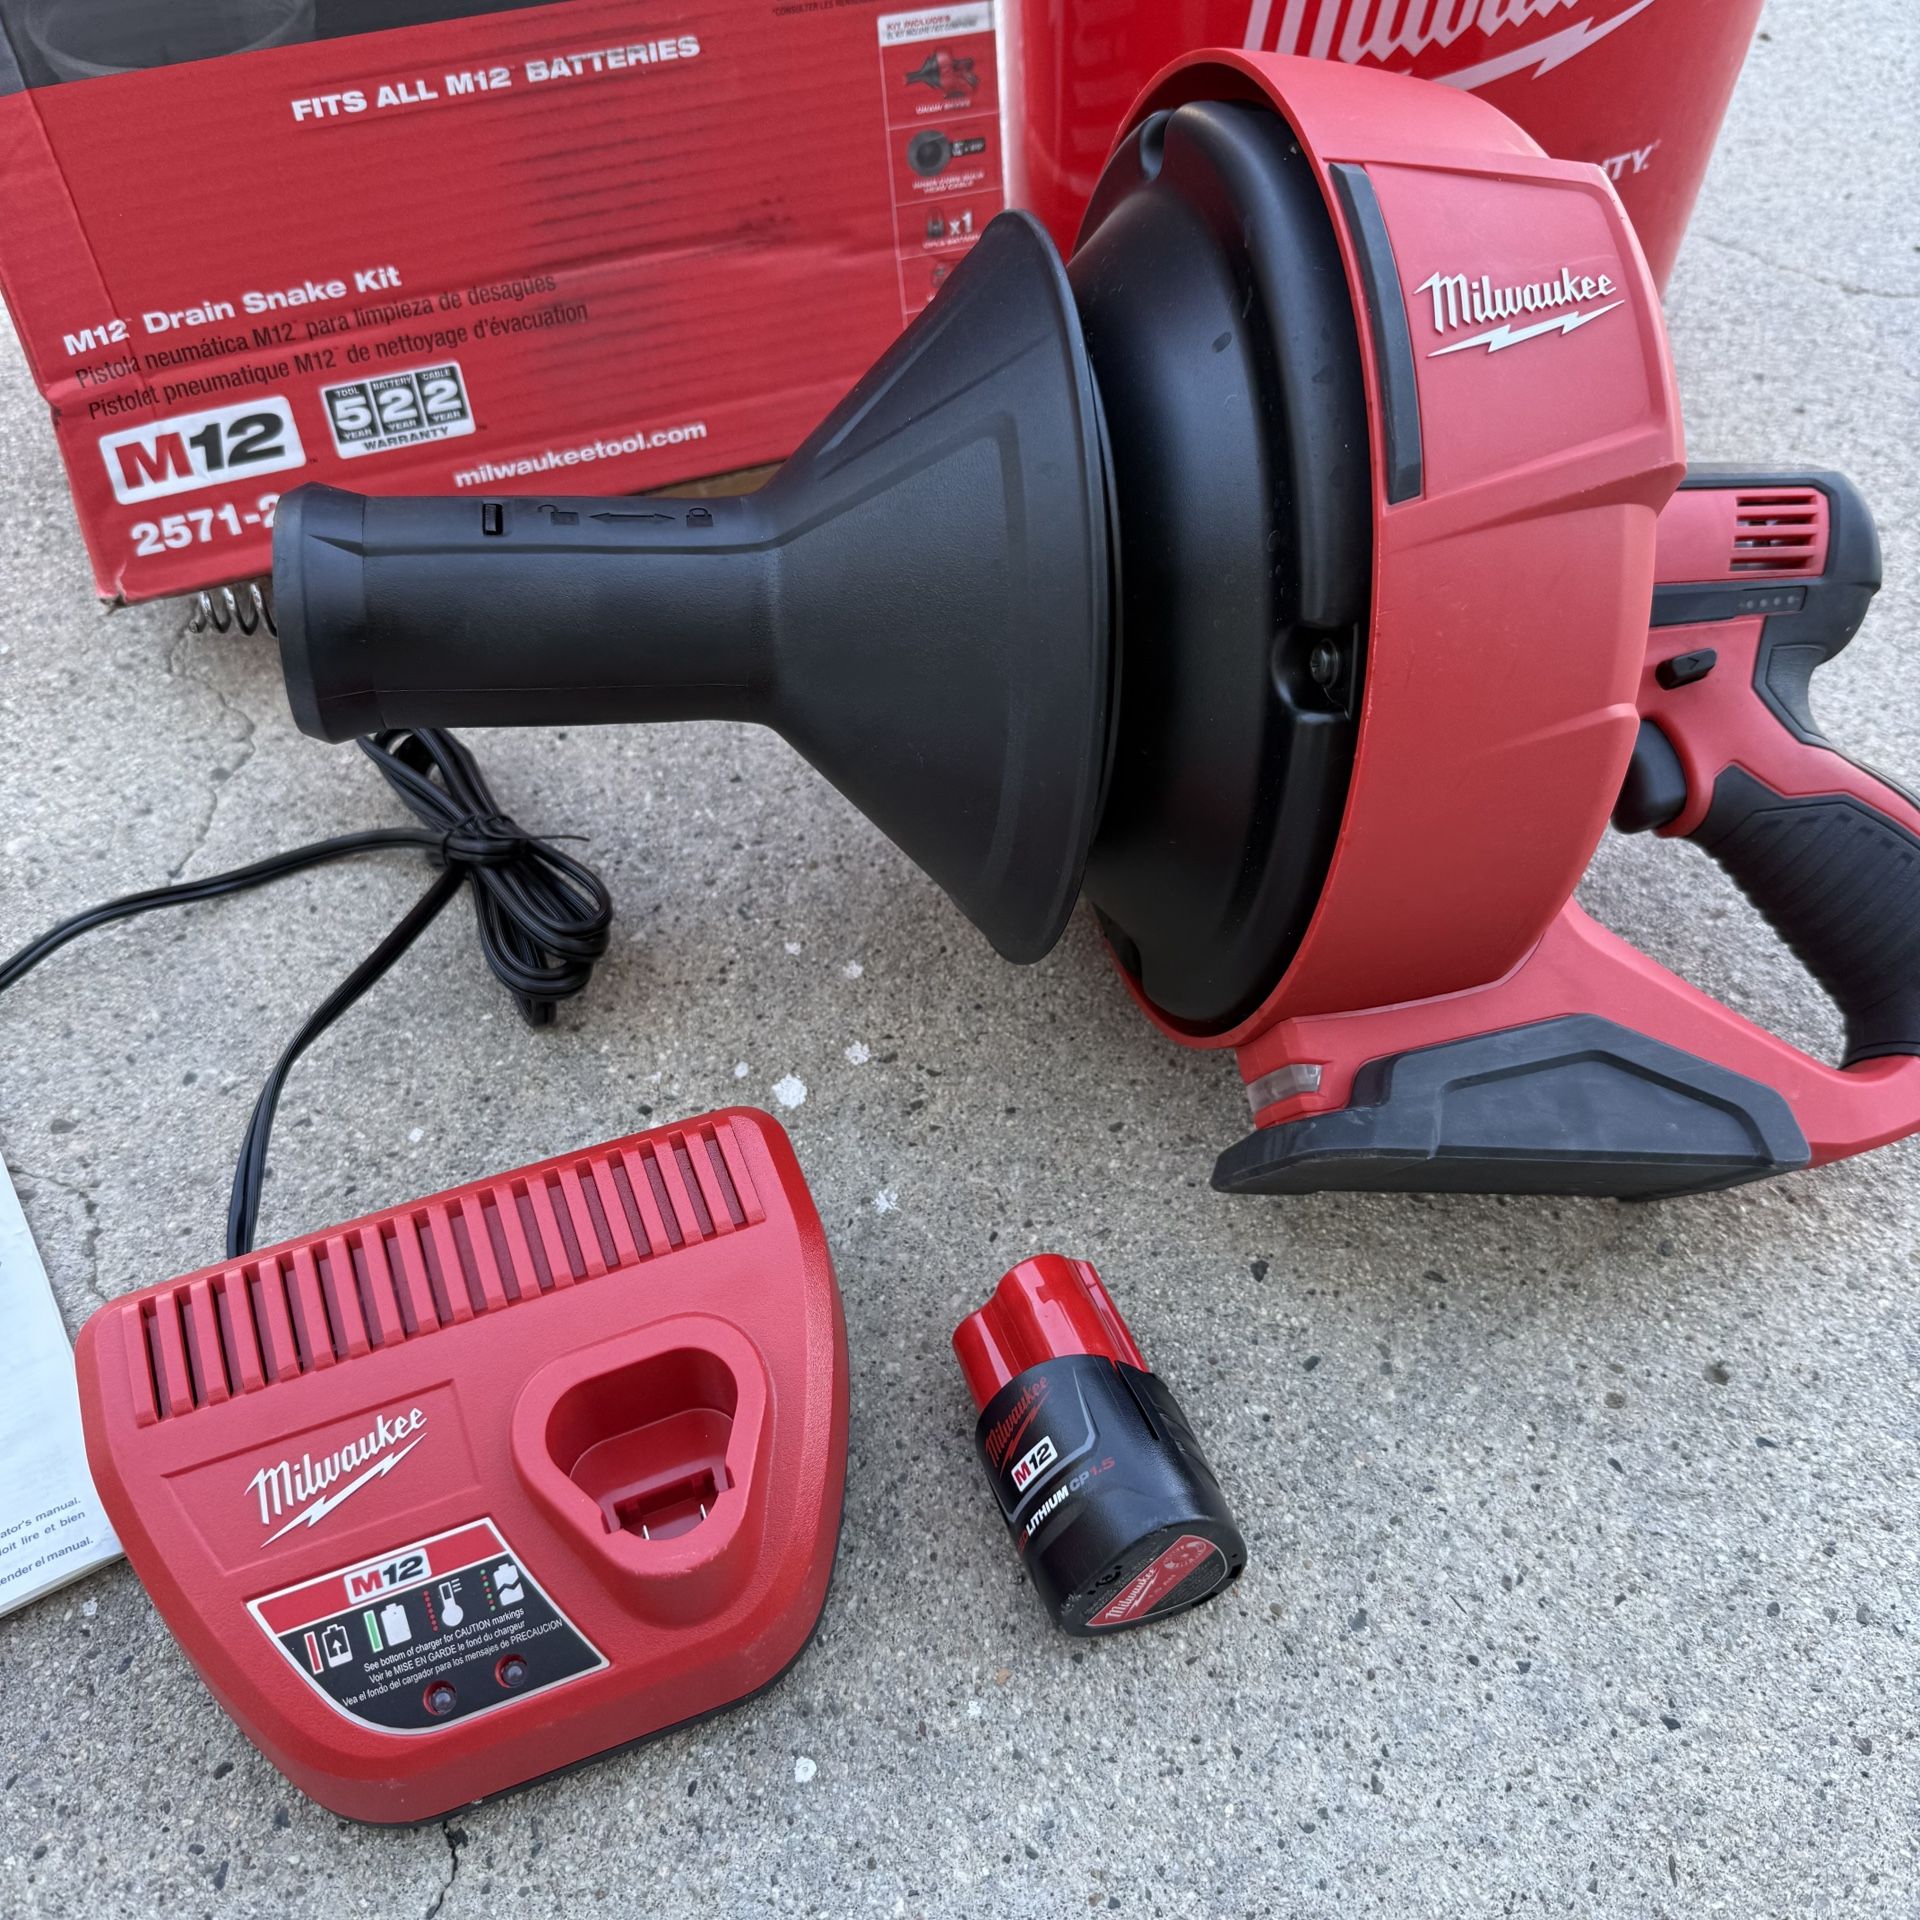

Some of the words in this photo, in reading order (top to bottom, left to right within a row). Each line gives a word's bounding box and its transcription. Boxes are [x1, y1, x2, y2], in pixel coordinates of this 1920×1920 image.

[291, 91, 367, 121] FITS
[377, 81, 438, 107] ALL
[525, 34, 701, 83] BATTERIES
[950, 211, 973, 235] x1
[75, 354, 141, 388] Pistola
[146, 335, 250, 370] neumática
[306, 315, 350, 340] para
[355, 299, 434, 328] limpieza
[439, 291, 462, 312] de
[467, 274, 557, 307] desagües
[143, 301, 236, 334] Drain
[241, 280, 347, 315] Snake
[354, 265, 402, 293] Kit
[1413, 267, 1617, 334] Milwaukee
[88, 386, 160, 420] Pistolet
[162, 361, 289, 405] pneumatique
[346, 343, 370, 364] de
[375, 327, 469, 358] nettoyage
[473, 302, 588, 340] d'évacuation
[336, 387, 360, 398] TOOL
[372, 376, 412, 391] BATTERY
[422, 369, 451, 381] CABLE
[335, 395, 373, 431] 5
[379, 388, 418, 423] 2
[424, 379, 462, 414] 2
[343, 428, 372, 441] YEAR
[388, 420, 417, 431] YEAR
[432, 411, 461, 422] YEAR
[115, 413, 286, 490] M12
[364, 425, 449, 452] WARRANTY
[454, 421, 708, 488] milwaukeetool.com
[131, 492, 280, 556] 2571-2
[986, 1375, 1048, 1469] Milwaukee
[244, 1408, 428, 1525] Milwaukee
[1013, 1442, 1053, 1487] M12
[0, 1519, 32, 1539] ator's
[35, 1497, 81, 1521] manual.
[0, 1541, 17, 1556] oit
[21, 1531, 39, 1545] lire
[44, 1523, 56, 1535] et
[60, 1511, 85, 1527] bien
[0, 1564, 33, 1586] ender
[35, 1556, 45, 1567] el
[47, 1536, 94, 1562] manual.
[351, 1556, 424, 1597] M12
[1105, 1566, 1157, 1620] Milwaukee
[342, 1696, 358, 1707] Vea
[359, 1691, 366, 1700] el
[366, 1685, 388, 1698] fondo
[389, 1679, 401, 1690] del
[401, 1667, 434, 1685] cargador
[434, 1660, 452, 1675] para
[453, 1657, 464, 1666] los
[464, 1643, 499, 1662] mensajes
[500, 1640, 510, 1649] de
[510, 1618, 563, 1645] PRECAUCION
[364, 1661, 379, 1672] See
[380, 1652, 406, 1667] bottom
[406, 1646, 415, 1657] of
[415, 1639, 442, 1654] charger
[443, 1633, 454, 1643] for
[454, 1619, 491, 1639] CAUTION
[492, 1608, 525, 1625] markings
[369, 1672, 384, 1683] Voir
[385, 1668, 393, 1678] le
[393, 1660, 414, 1675] MISE
[415, 1656, 428, 1667] EN
[427, 1645, 458, 1663] GARDE
[458, 1643, 465, 1651] le
[465, 1636, 482, 1648] fond
[483, 1633, 493, 1642] du
[494, 1620, 526, 1638] chargeur
